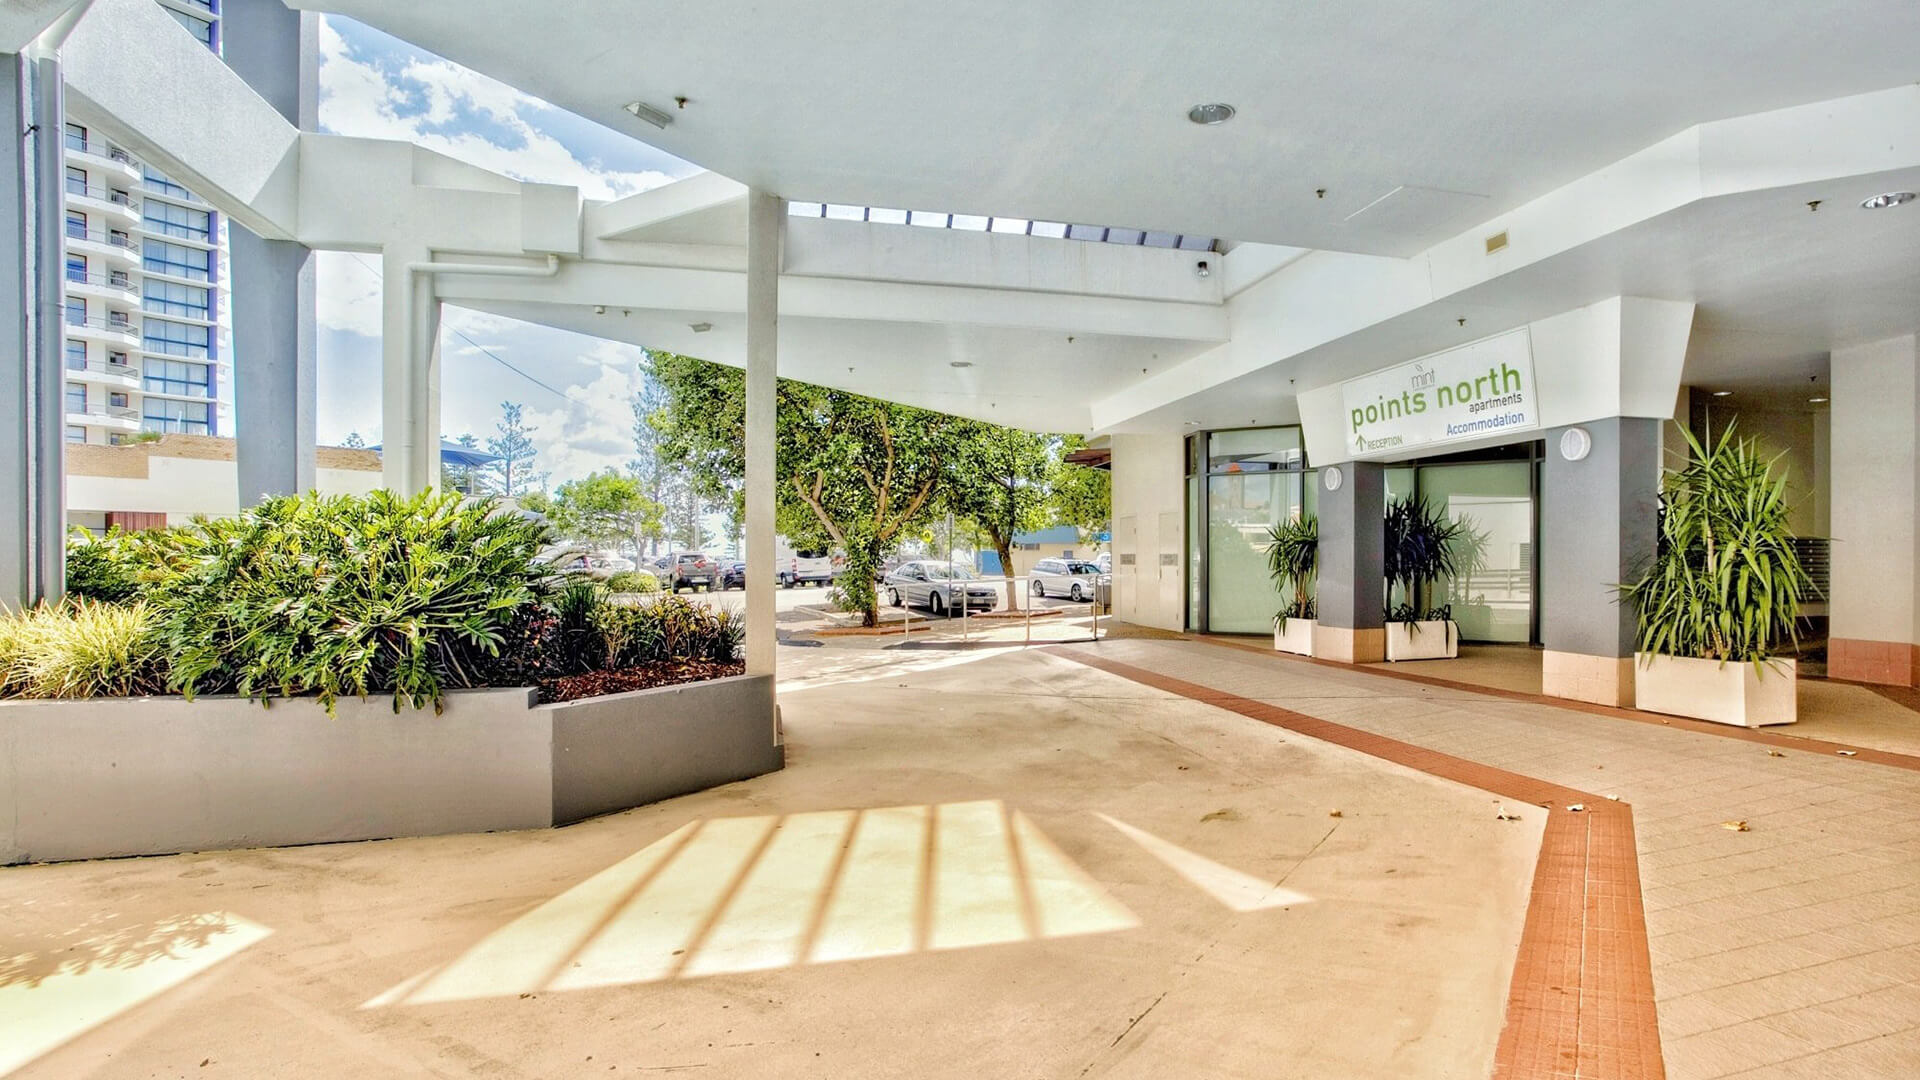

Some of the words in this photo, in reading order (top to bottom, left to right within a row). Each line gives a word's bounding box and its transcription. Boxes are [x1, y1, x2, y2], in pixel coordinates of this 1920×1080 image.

[1411, 368, 1435, 389] mint
[1352, 391, 1427, 433] points
[1437, 363, 1521, 408] north
[1469, 393, 1523, 414] apartments
[1447, 411, 1525, 436] Accommodation
[1367, 435, 1403, 450] RECEPTION
